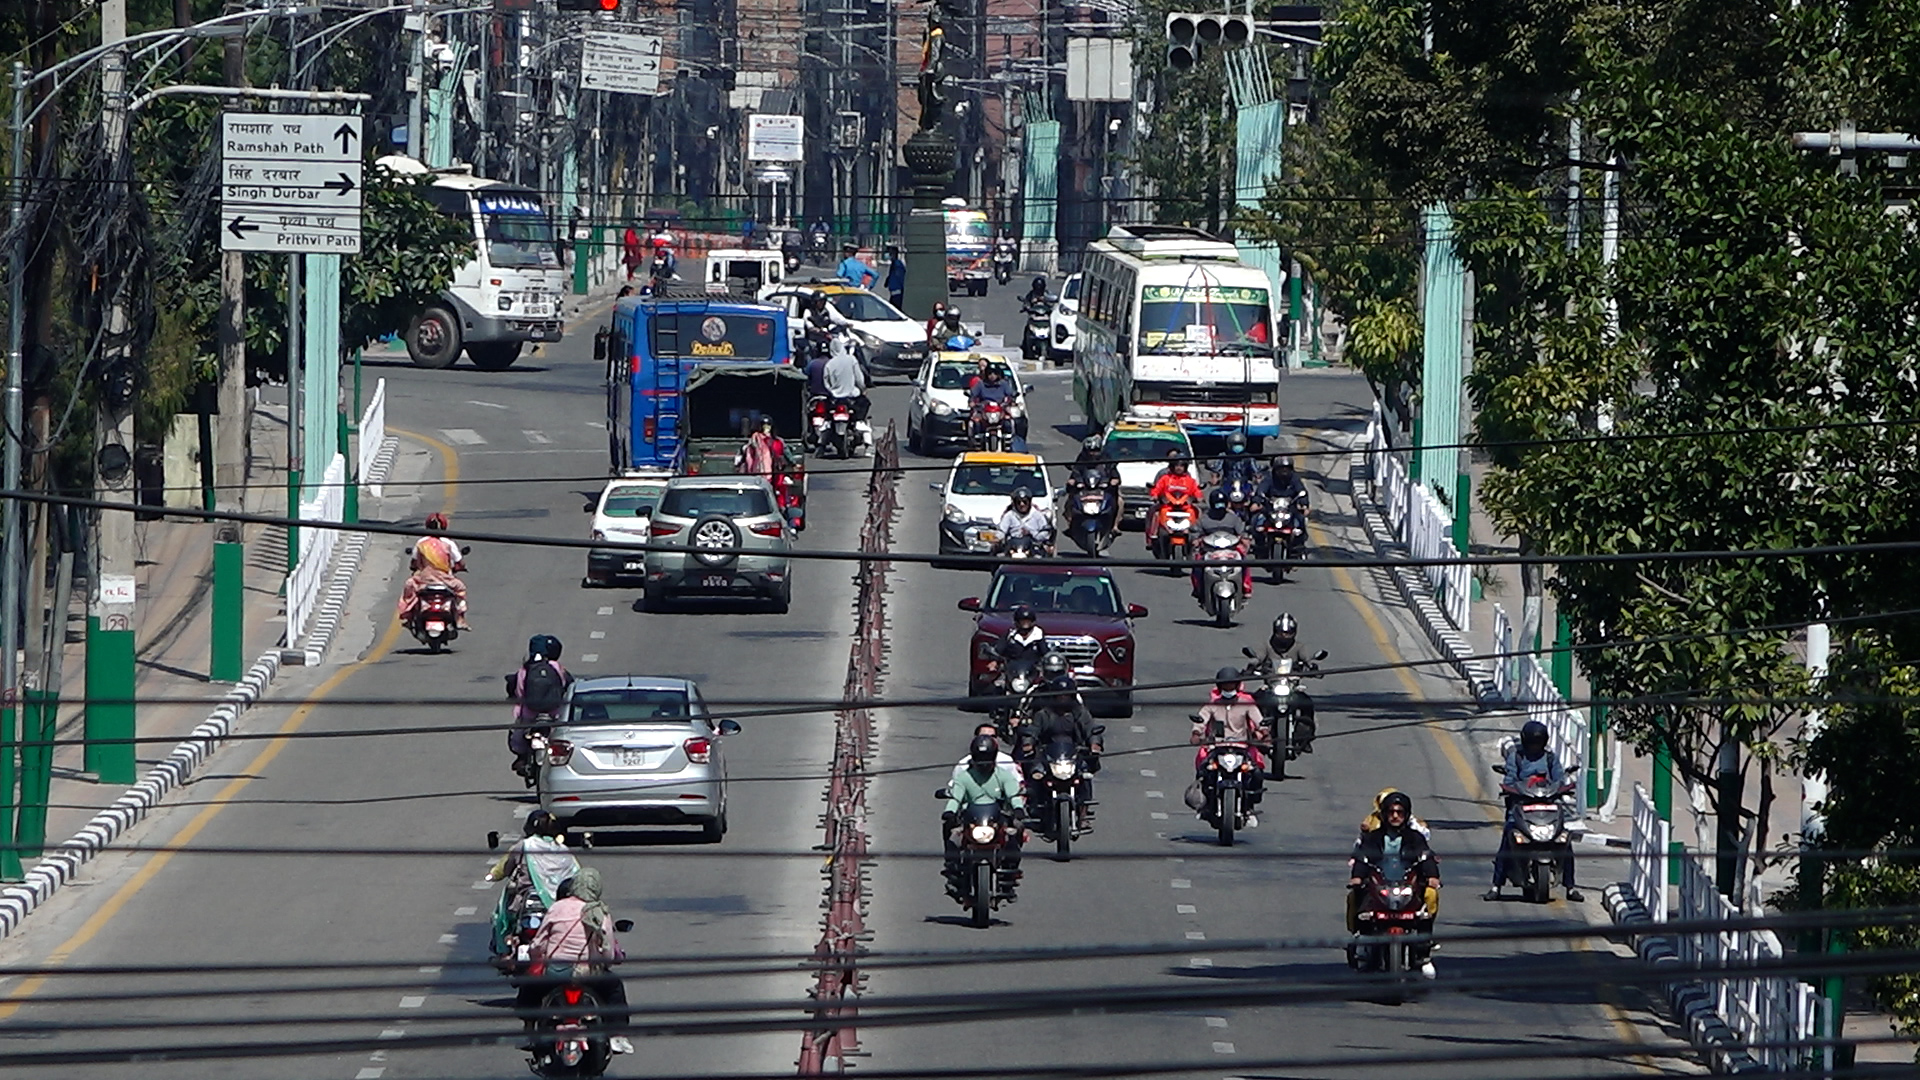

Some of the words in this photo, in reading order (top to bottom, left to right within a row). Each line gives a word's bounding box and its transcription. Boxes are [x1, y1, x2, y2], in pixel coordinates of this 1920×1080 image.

[228, 122, 273, 136] रामशाह
[282, 124, 302, 135] पथ
[227, 140, 289, 154] Ramshah
[293, 142, 325, 154] Path
[228, 163, 253, 180] सिंह
[262, 168, 301, 181] दरबार
[227, 185, 267, 200] Singh
[272, 185, 320, 199] Durbar
[484, 195, 541, 212] VOLVO
[276, 233, 320, 245] Prithvi
[326, 234, 357, 246] Path
